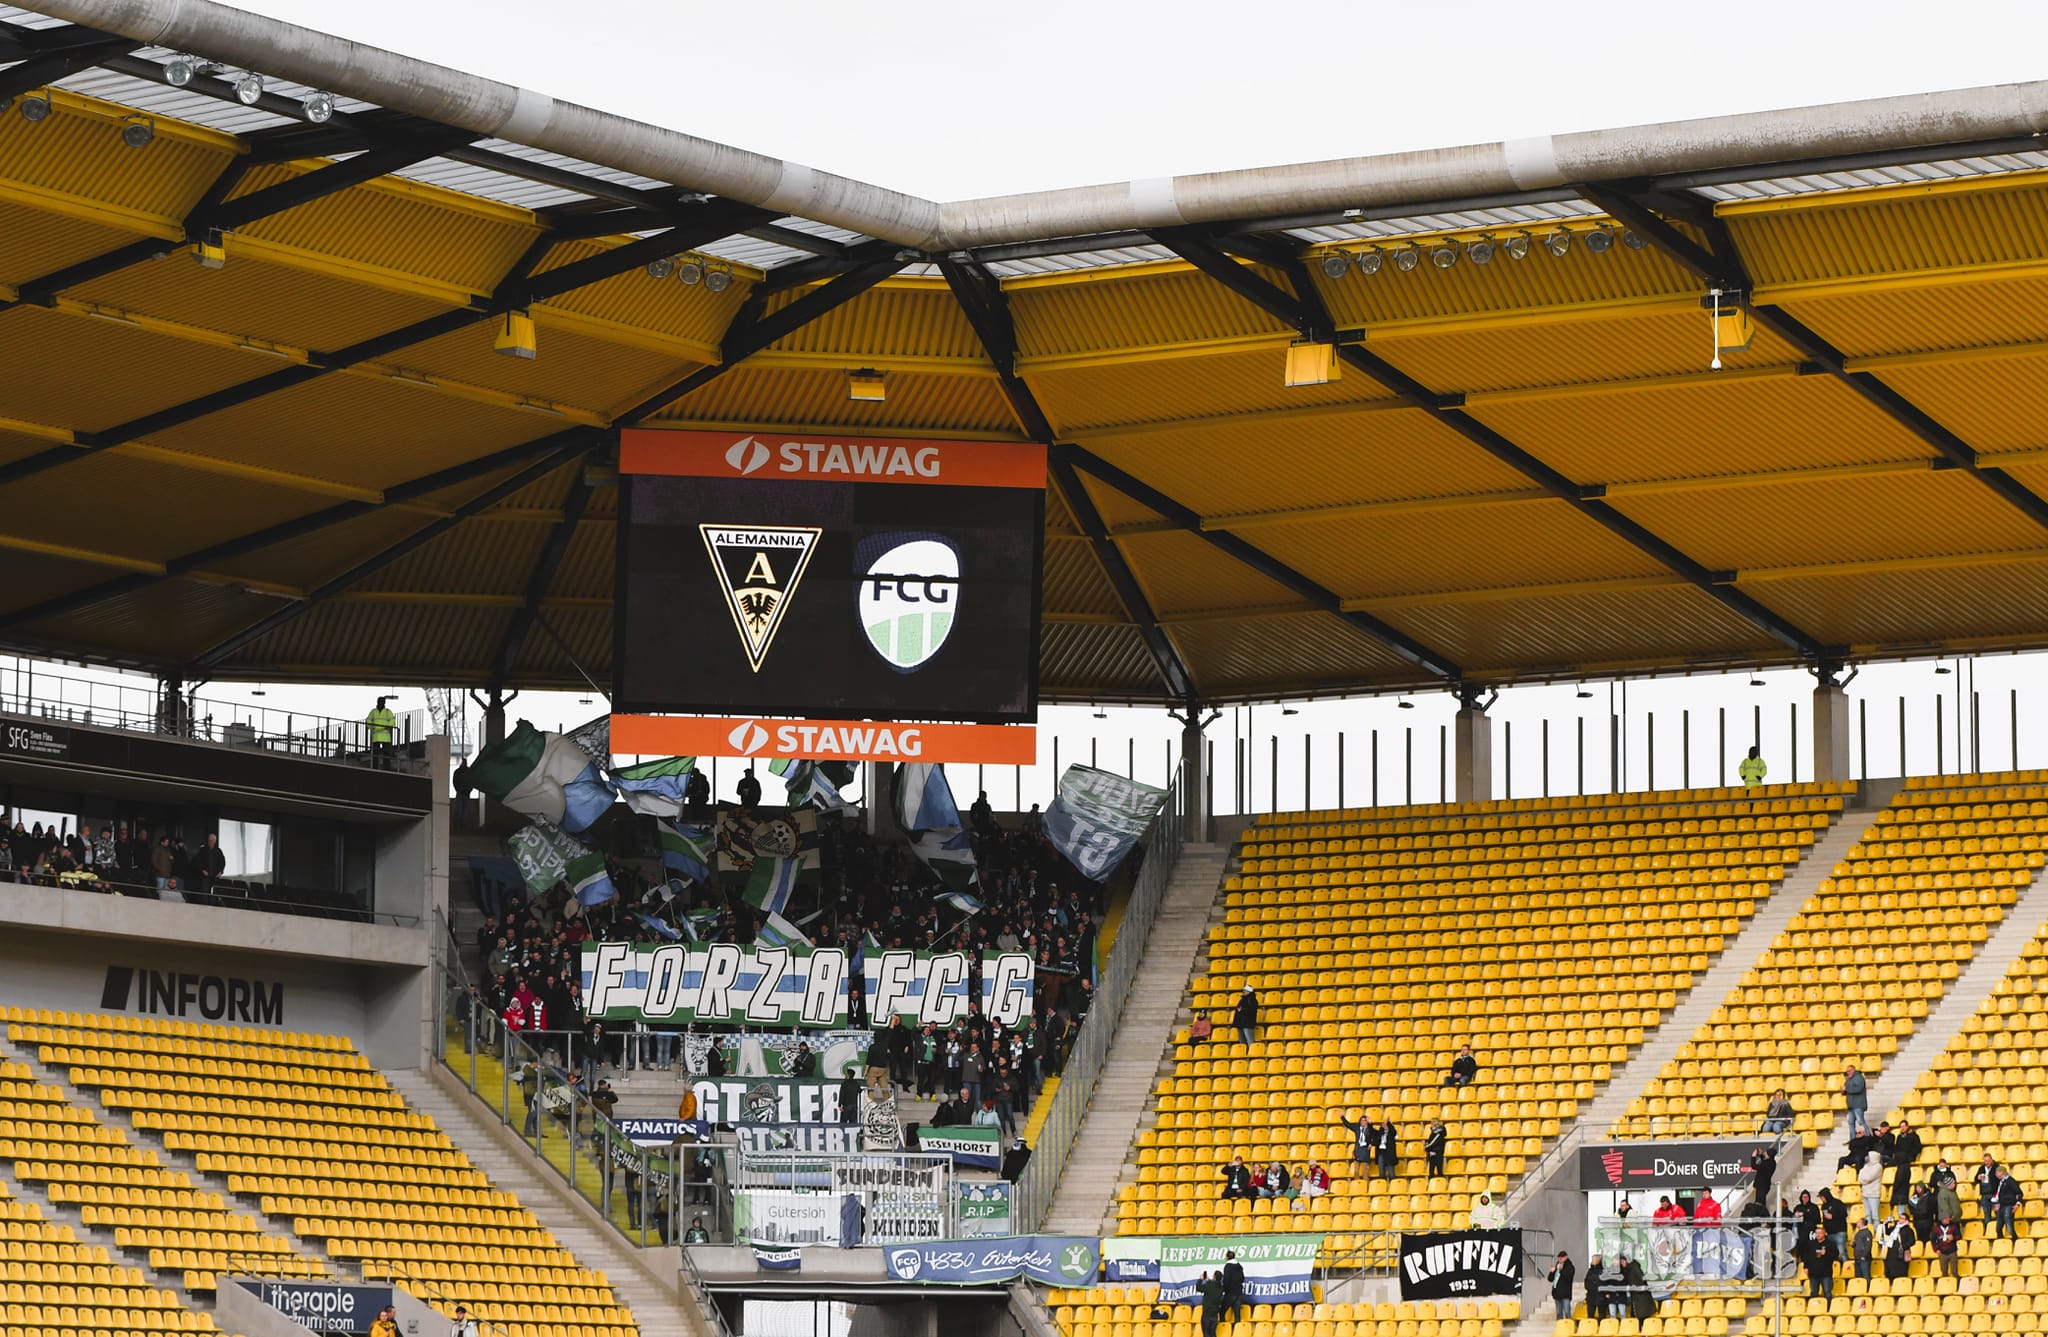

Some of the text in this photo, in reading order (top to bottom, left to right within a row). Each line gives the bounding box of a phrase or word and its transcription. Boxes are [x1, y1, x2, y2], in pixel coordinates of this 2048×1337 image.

[779, 442, 941, 478] STAWAG
[715, 533, 806, 547] ALEMANNIA
[744, 552, 777, 585] A
[872, 573, 949, 603] FCG
[8, 726, 29, 750] SFG
[776, 725, 922, 757] STAWAG
[138, 968, 284, 1026] INFORM
[586, 942, 1032, 1028] FORZA FCG
[1654, 1159, 1740, 1179] DÖNER CENTER
[768, 1206, 826, 1219] Gütersloh
[872, 1219, 940, 1237] MINDEN
[924, 1250, 975, 1271] 4830
[1162, 1246, 1206, 1263] LEFFE
[1248, 1244, 1275, 1259] ON
[1275, 1243, 1318, 1257] TOUR
[1403, 1240, 1517, 1285] RUFFEL
[1449, 1279, 1477, 1292] 1982
[271, 1284, 355, 1317] therapie
